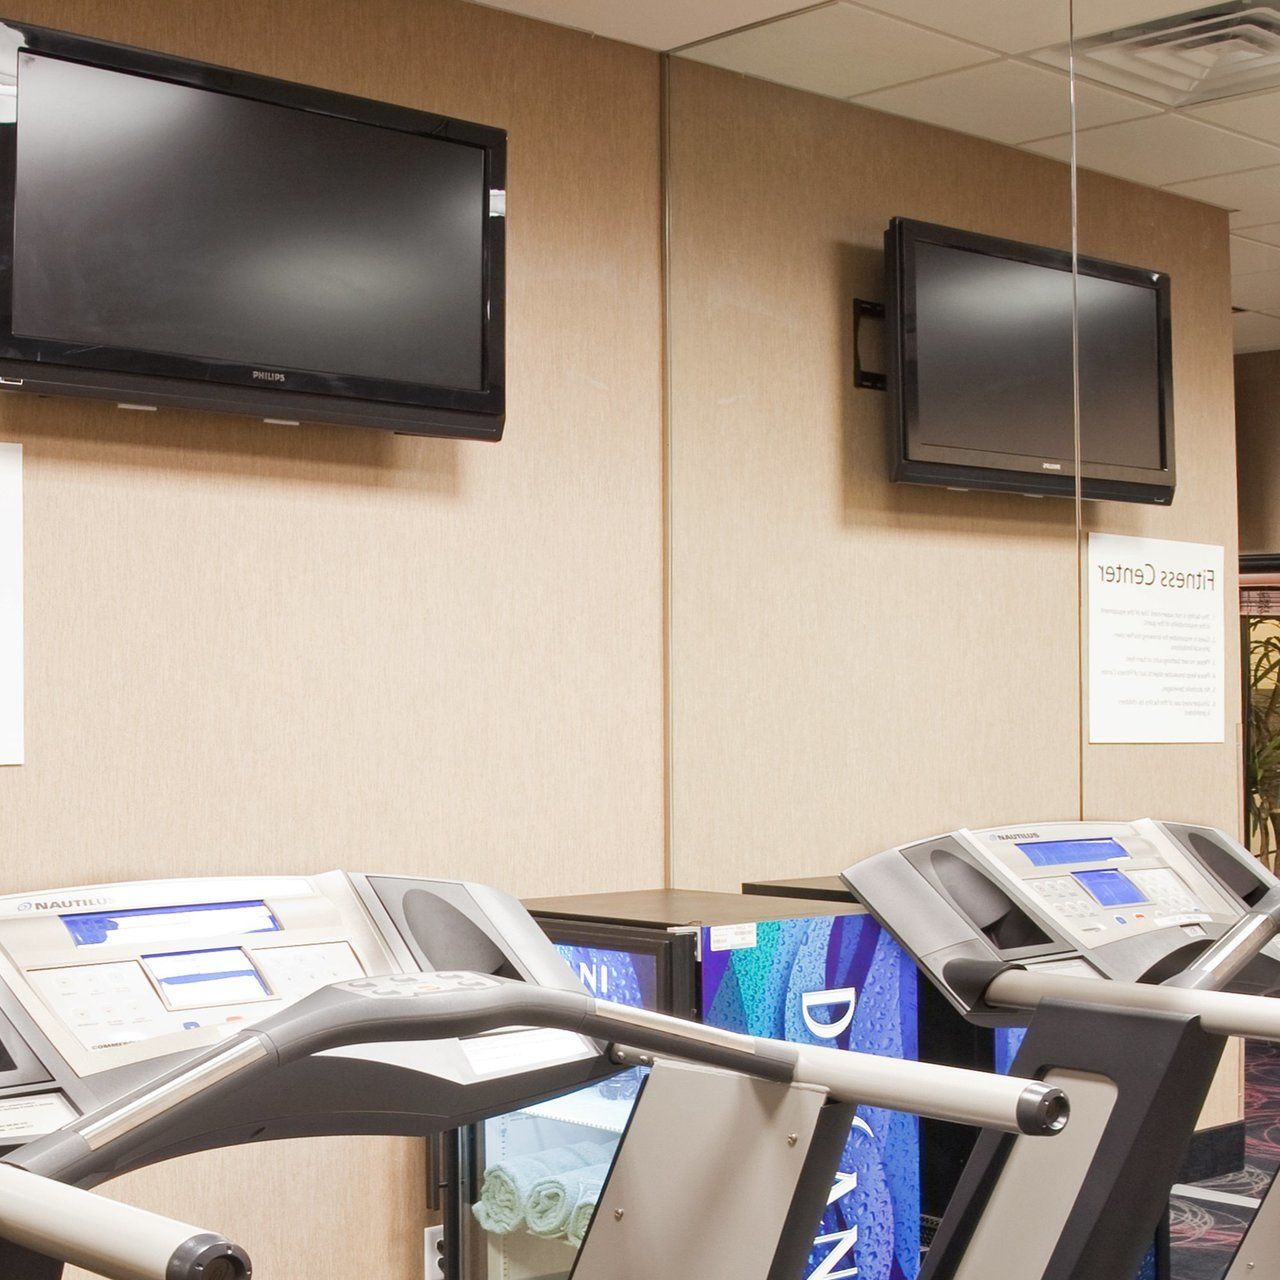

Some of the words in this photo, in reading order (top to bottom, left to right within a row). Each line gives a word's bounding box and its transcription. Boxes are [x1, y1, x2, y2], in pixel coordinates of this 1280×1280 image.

[252, 370, 286, 382] PHILIPS
[997, 832, 1040, 841] NAUTILUS
[35, 897, 112, 910] NAUTILU
